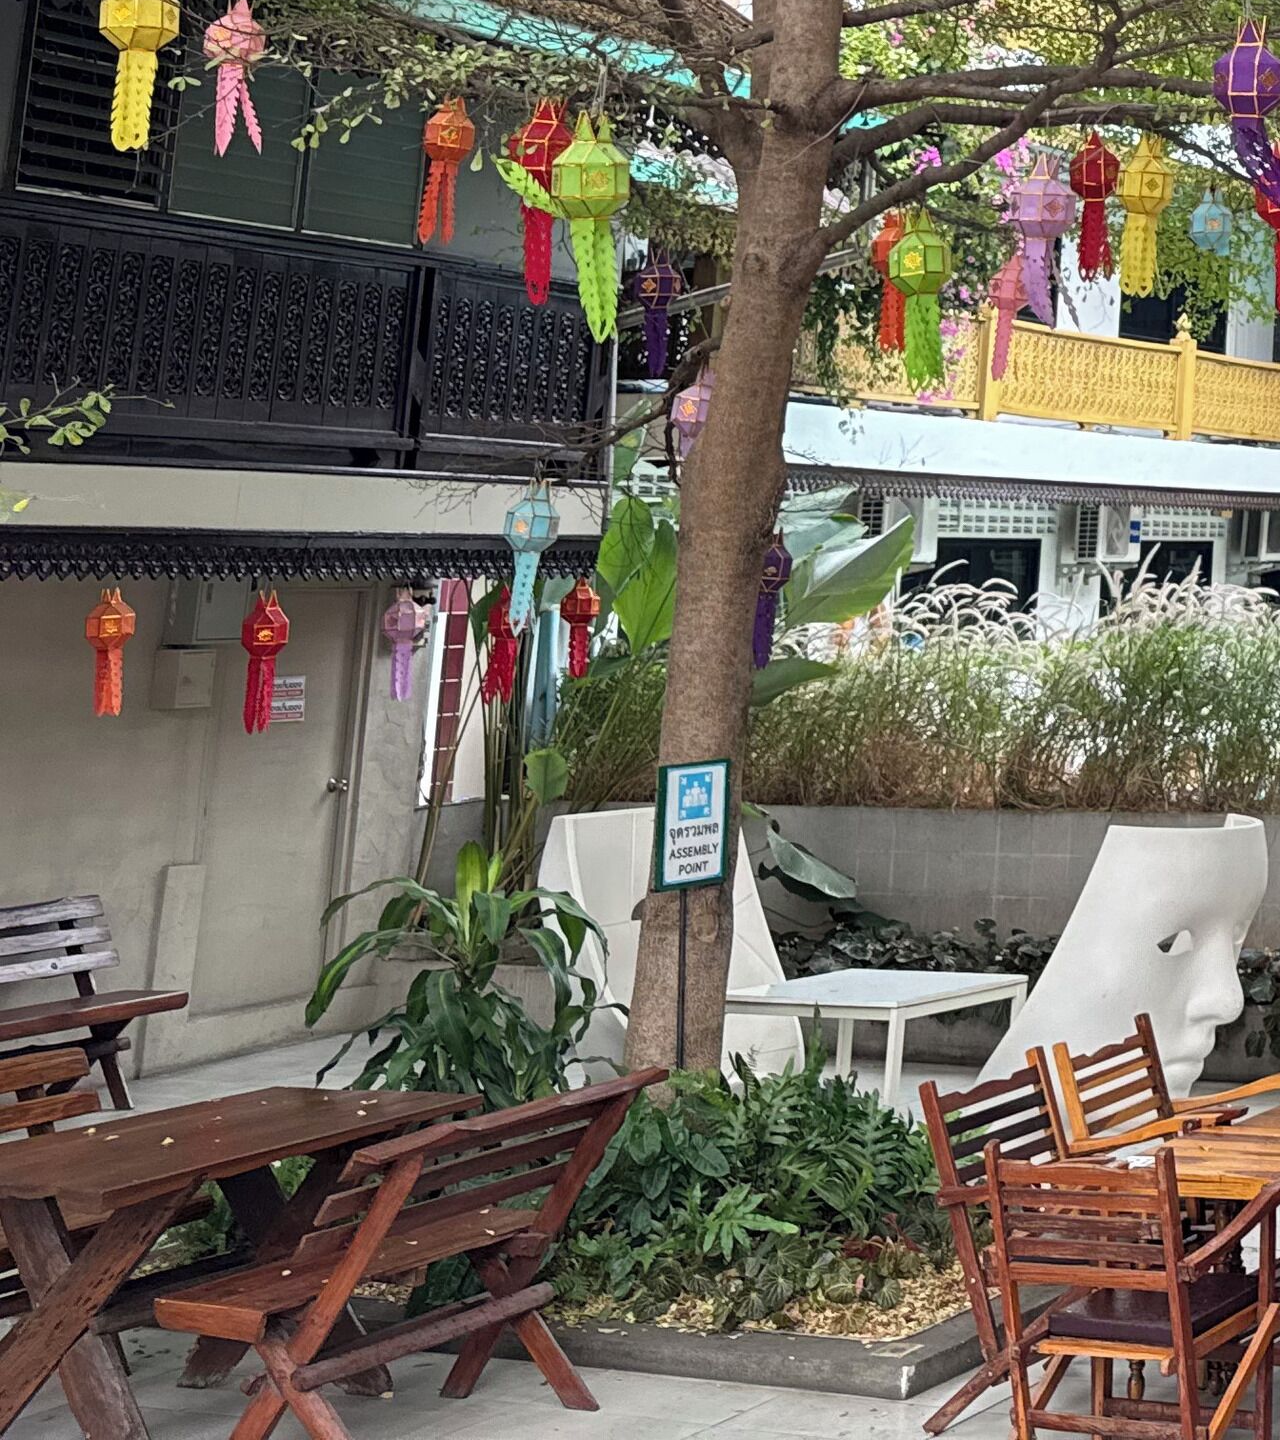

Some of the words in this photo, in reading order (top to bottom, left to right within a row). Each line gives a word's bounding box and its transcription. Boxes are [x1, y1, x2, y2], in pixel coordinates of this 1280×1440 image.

[669, 822, 719, 845] จุดรวมพล
[668, 842, 719, 860] ASSEMBLY
[678, 861, 709, 875] POINT
